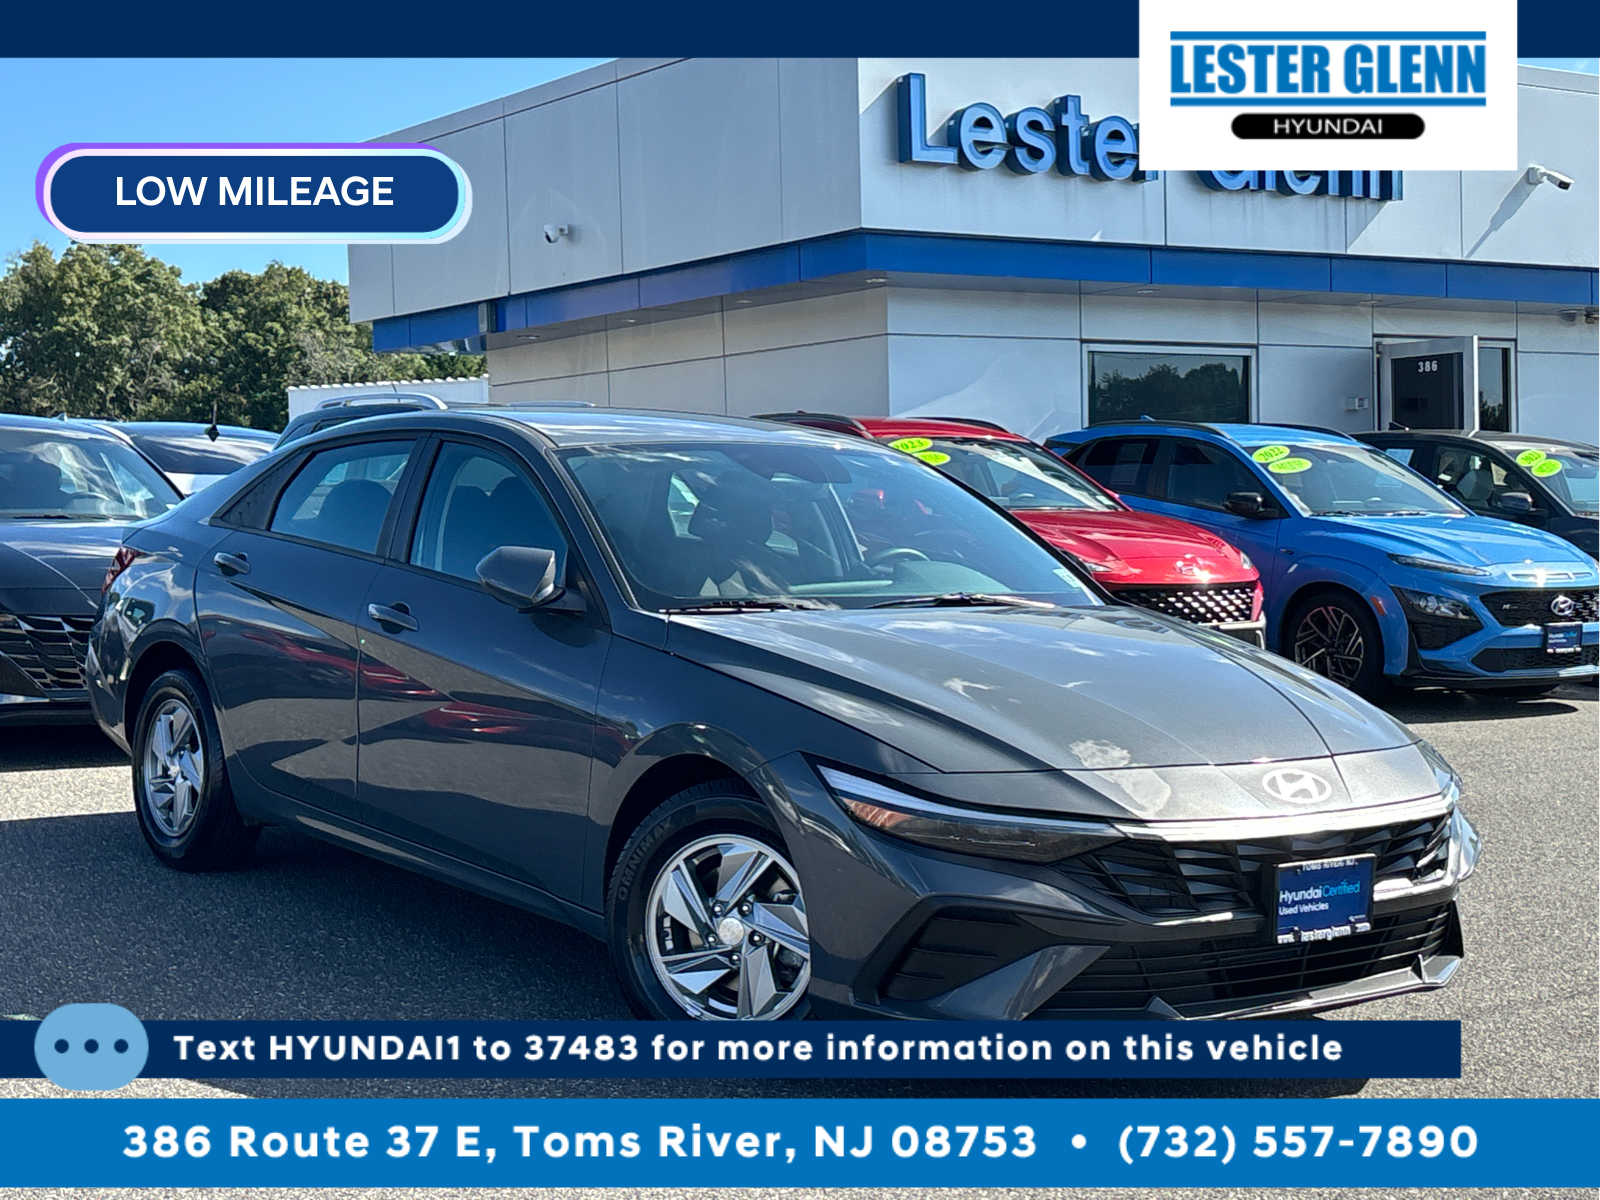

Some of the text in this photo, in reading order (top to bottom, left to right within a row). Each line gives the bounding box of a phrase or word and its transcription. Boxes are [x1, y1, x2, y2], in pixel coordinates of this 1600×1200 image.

[897, 73, 1158, 183] Leste
[1417, 360, 1438, 373] 386
[1278, 901, 1329, 916] Used Vehicles
